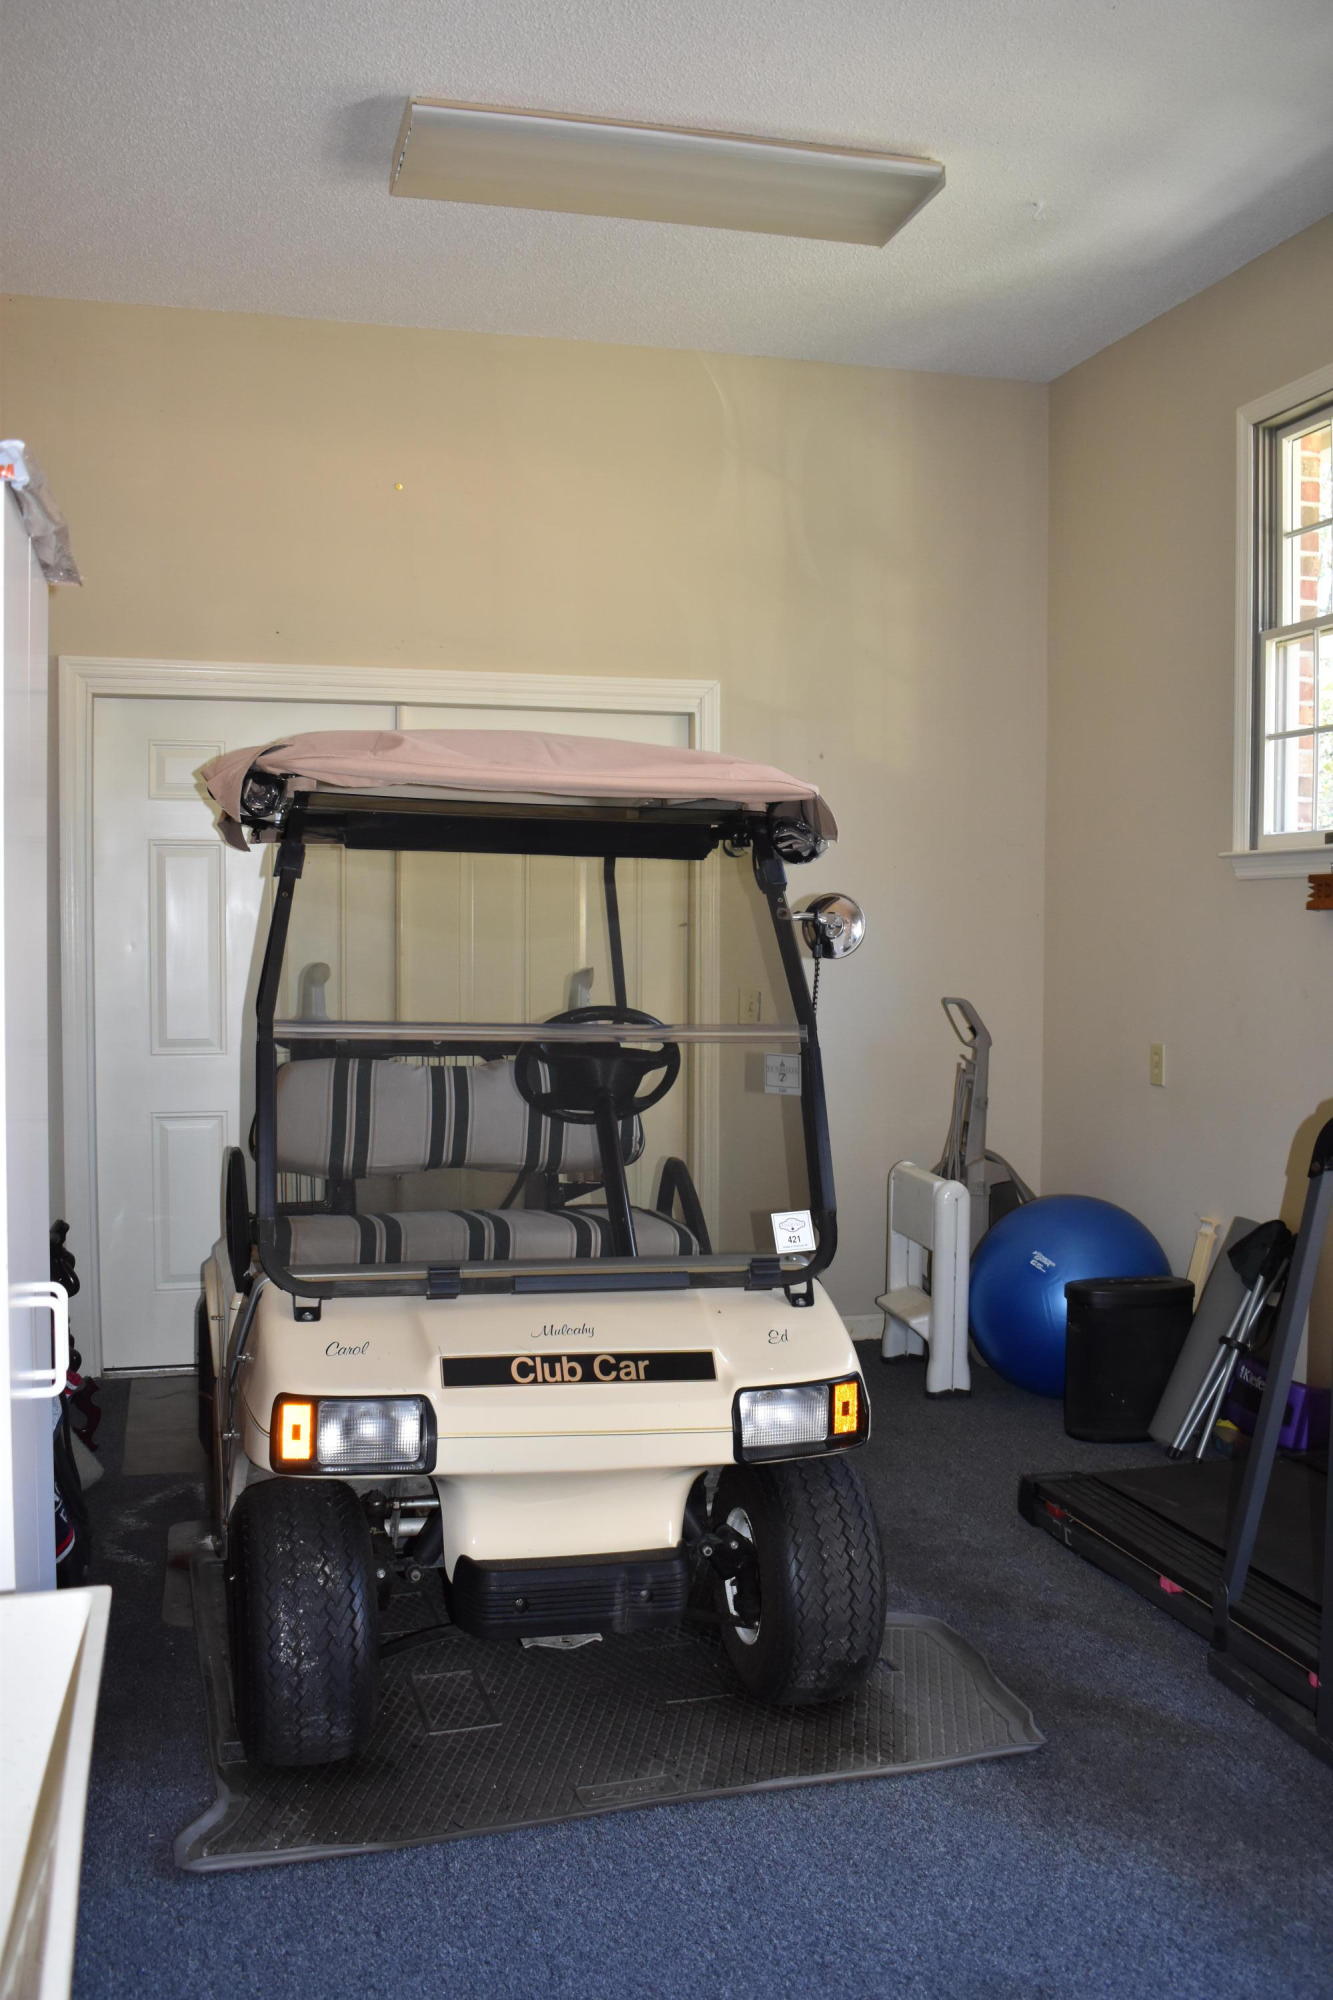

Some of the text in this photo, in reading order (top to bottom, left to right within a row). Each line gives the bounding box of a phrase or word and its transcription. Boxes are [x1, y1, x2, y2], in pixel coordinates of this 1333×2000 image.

[787, 1235, 801, 1244] 421
[531, 1322, 595, 1338] Mulcahy
[767, 1328, 789, 1345] Ed
[325, 1341, 370, 1357] Carol
[510, 1354, 650, 1384] Club Car
